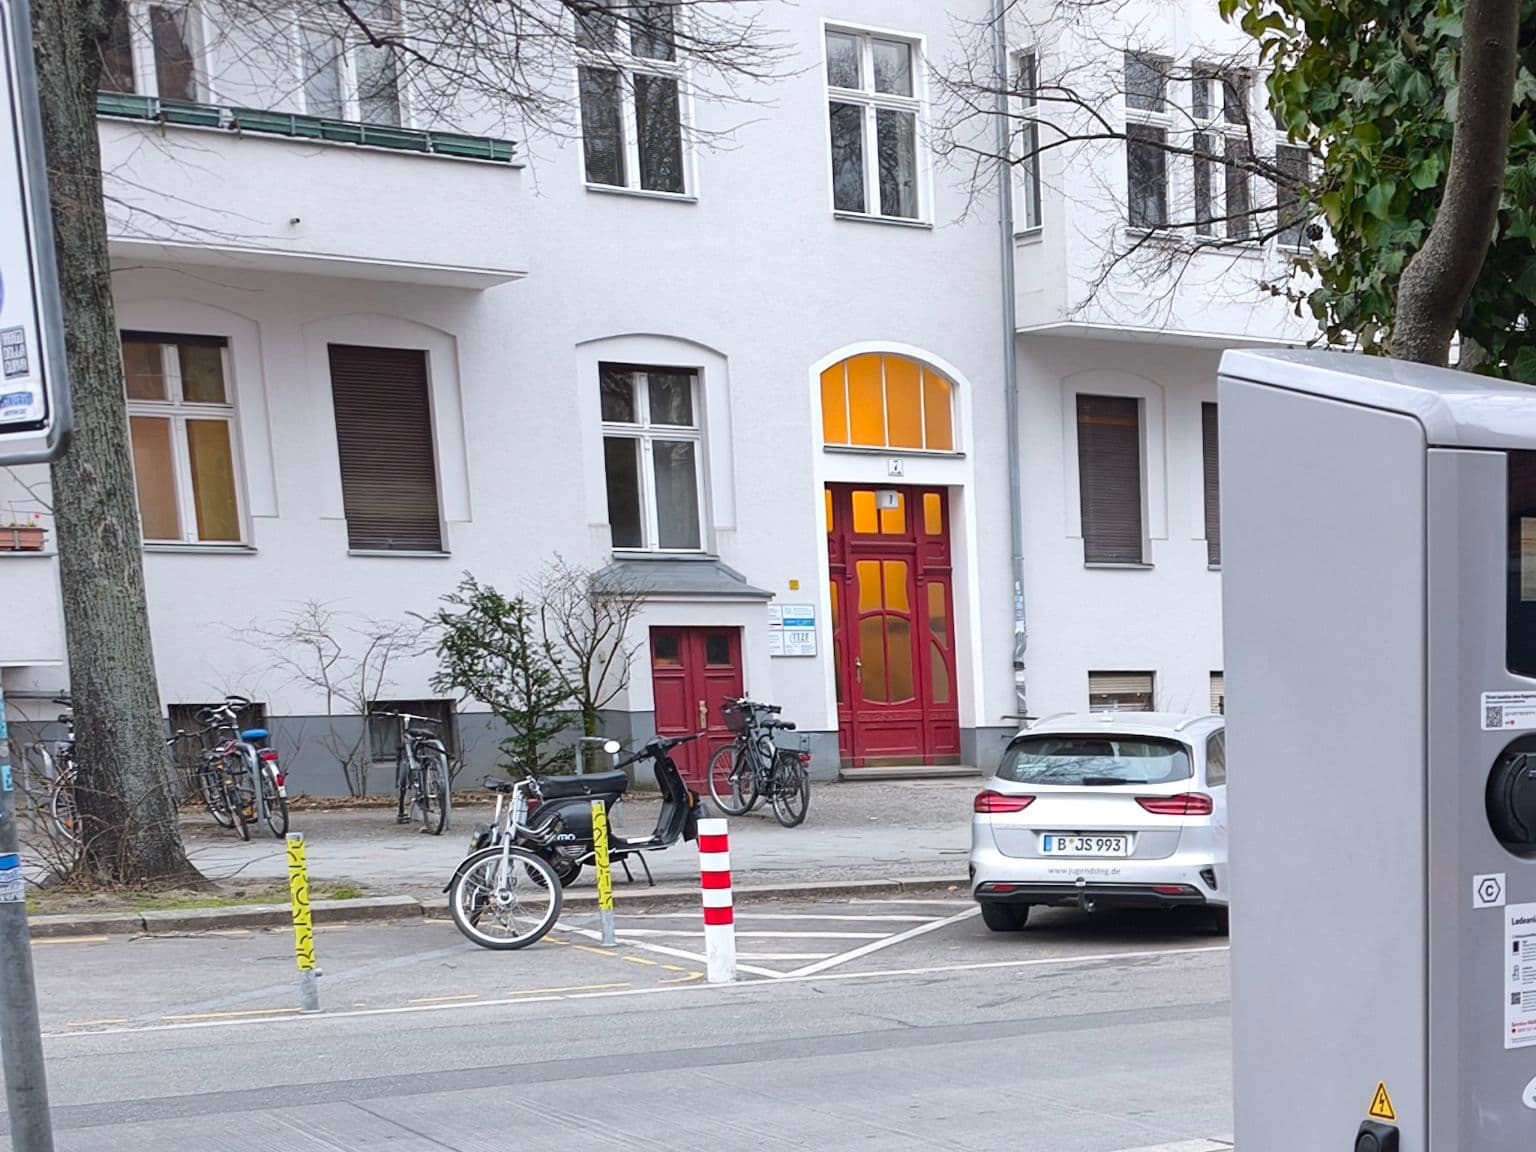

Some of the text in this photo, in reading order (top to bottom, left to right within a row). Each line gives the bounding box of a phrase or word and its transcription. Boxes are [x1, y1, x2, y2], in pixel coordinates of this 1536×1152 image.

[1057, 838, 1121, 852] B JS 993
[1485, 885, 1494, 897] C
